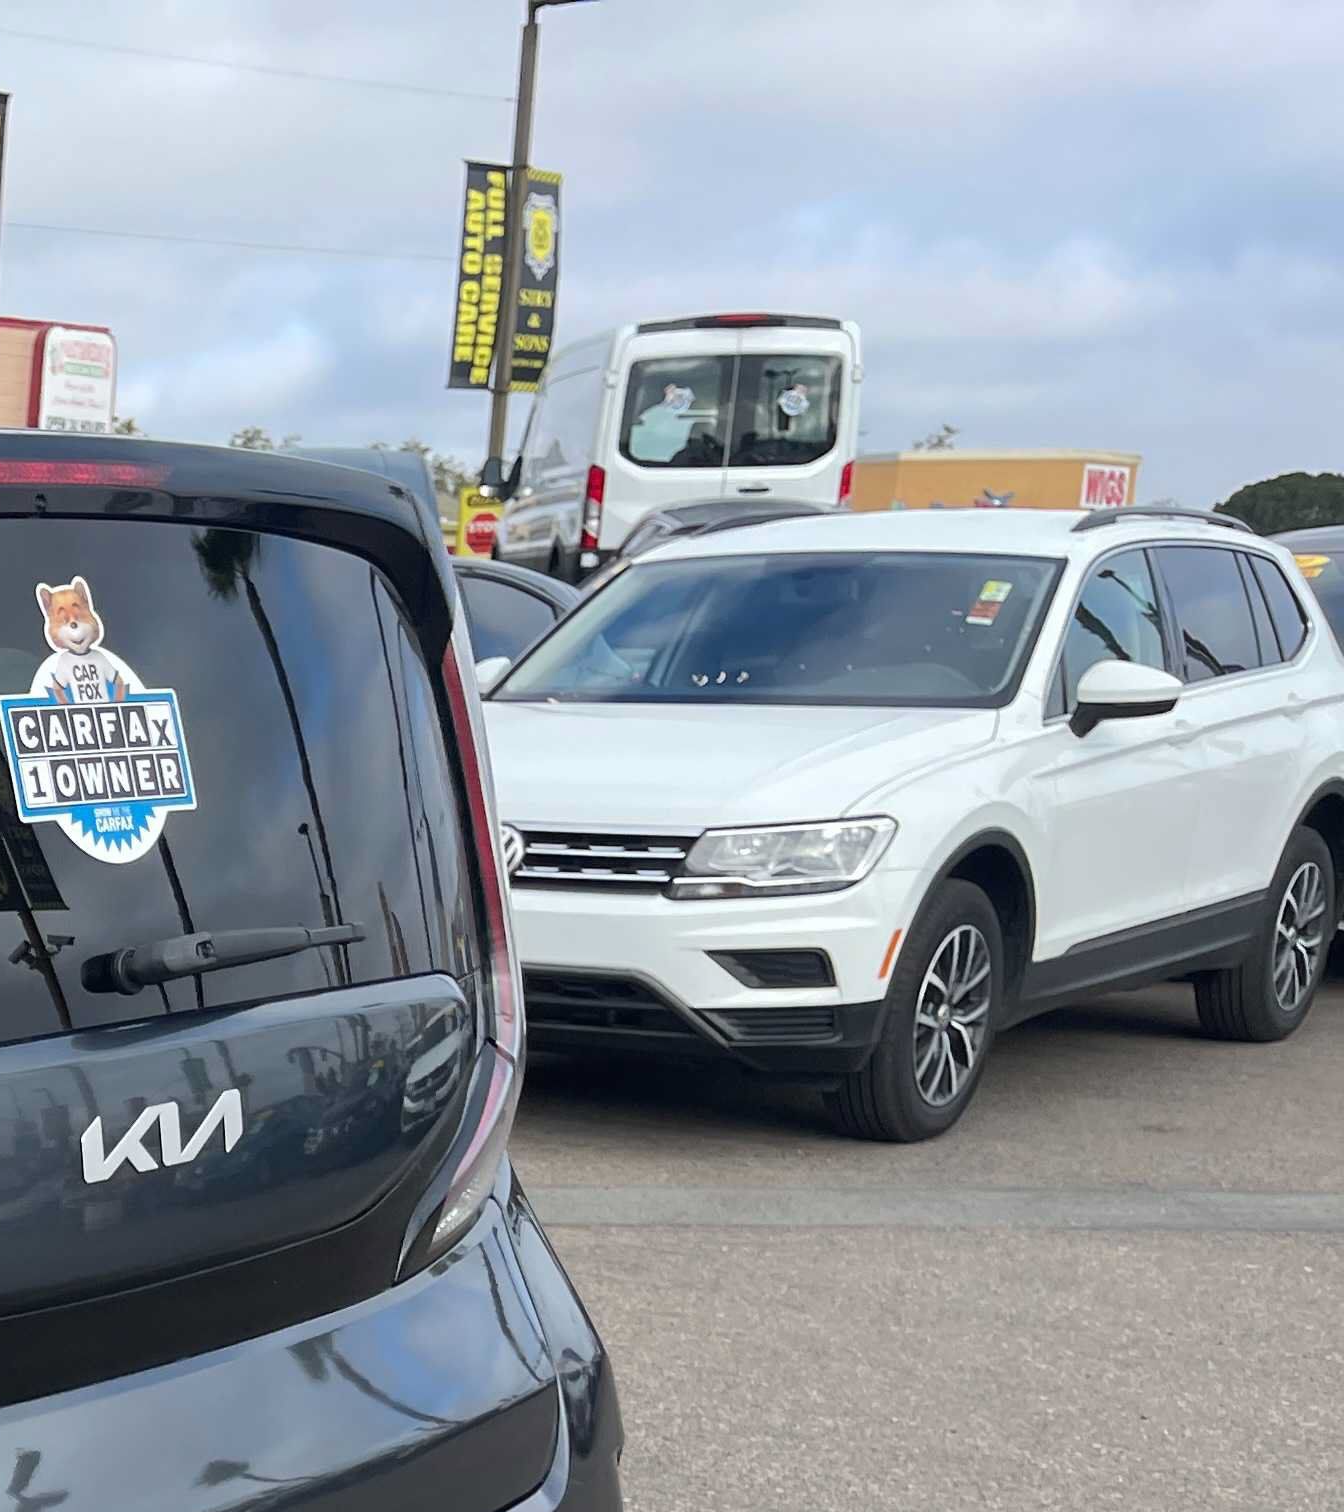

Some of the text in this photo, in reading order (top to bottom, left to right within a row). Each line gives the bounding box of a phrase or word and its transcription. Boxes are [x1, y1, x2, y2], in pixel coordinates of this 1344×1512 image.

[454, 188, 486, 362] AUTO CARE
[470, 170, 506, 384] FULL SERVICE
[1086, 469, 1126, 505] WIGS
[72, 664, 100, 682] CAR
[77, 682, 102, 700] FOX
[17, 710, 175, 750] CARFAX
[96, 816, 134, 832] CARFAX
[80, 1088, 244, 1184] KIA
